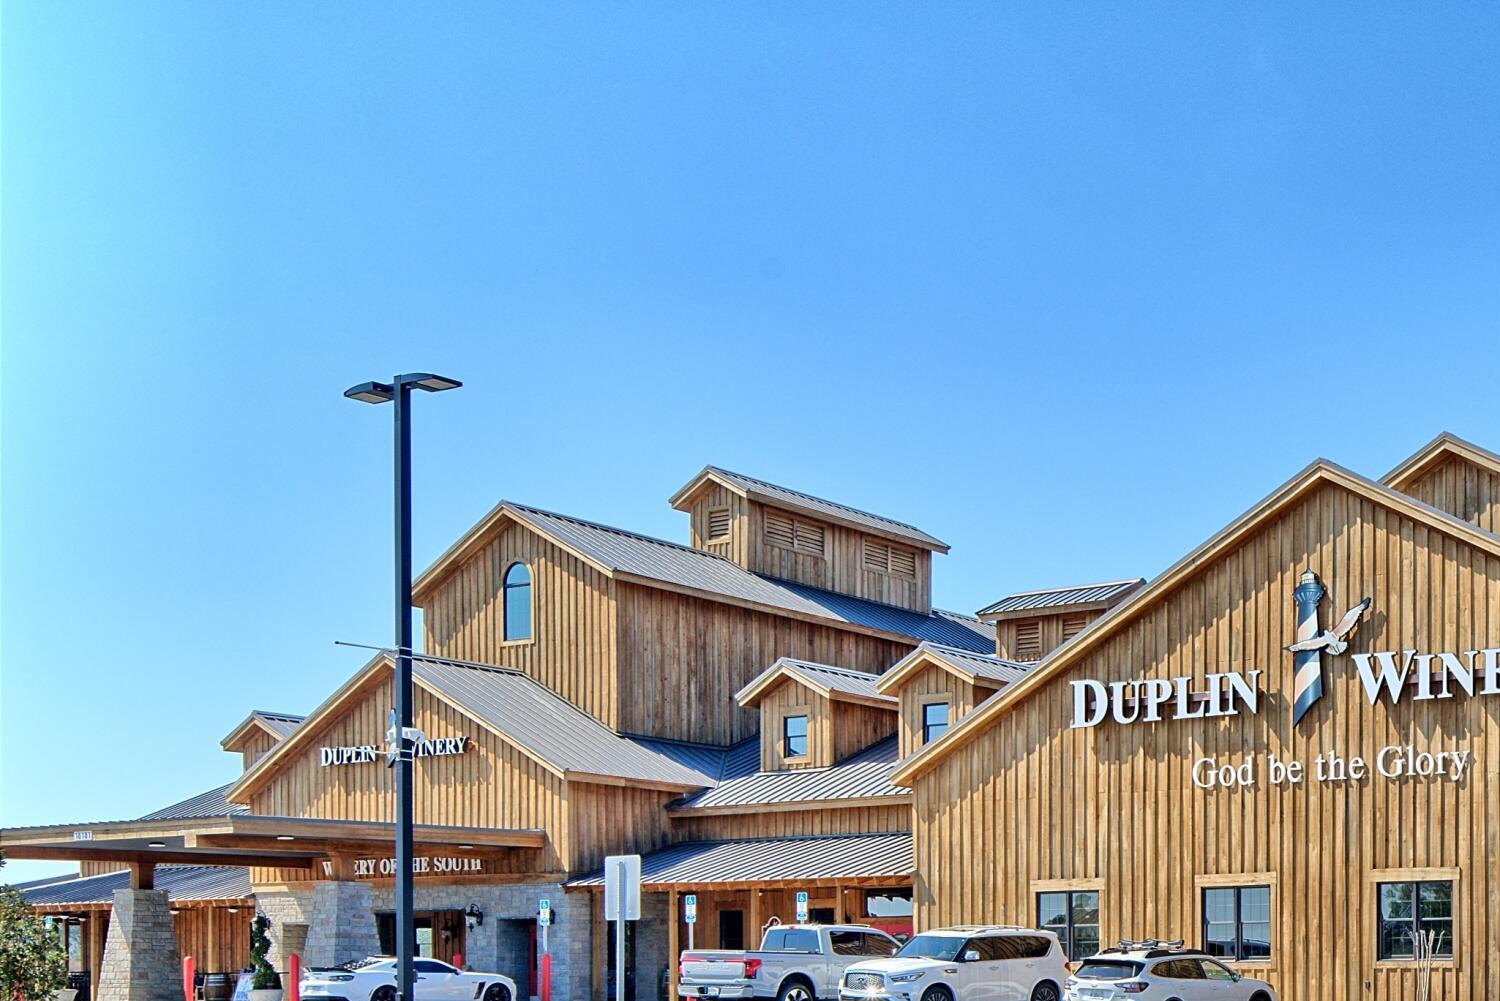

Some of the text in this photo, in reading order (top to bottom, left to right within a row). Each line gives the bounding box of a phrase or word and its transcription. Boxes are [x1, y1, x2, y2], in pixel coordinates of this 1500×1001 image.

[1069, 669, 1263, 729] DUPLIN
[320, 744, 377, 767] DUPLIN
[1192, 745, 1471, 788] God be the Glory
[412, 857, 430, 872] HE
[433, 857, 482, 872] SOUTH
